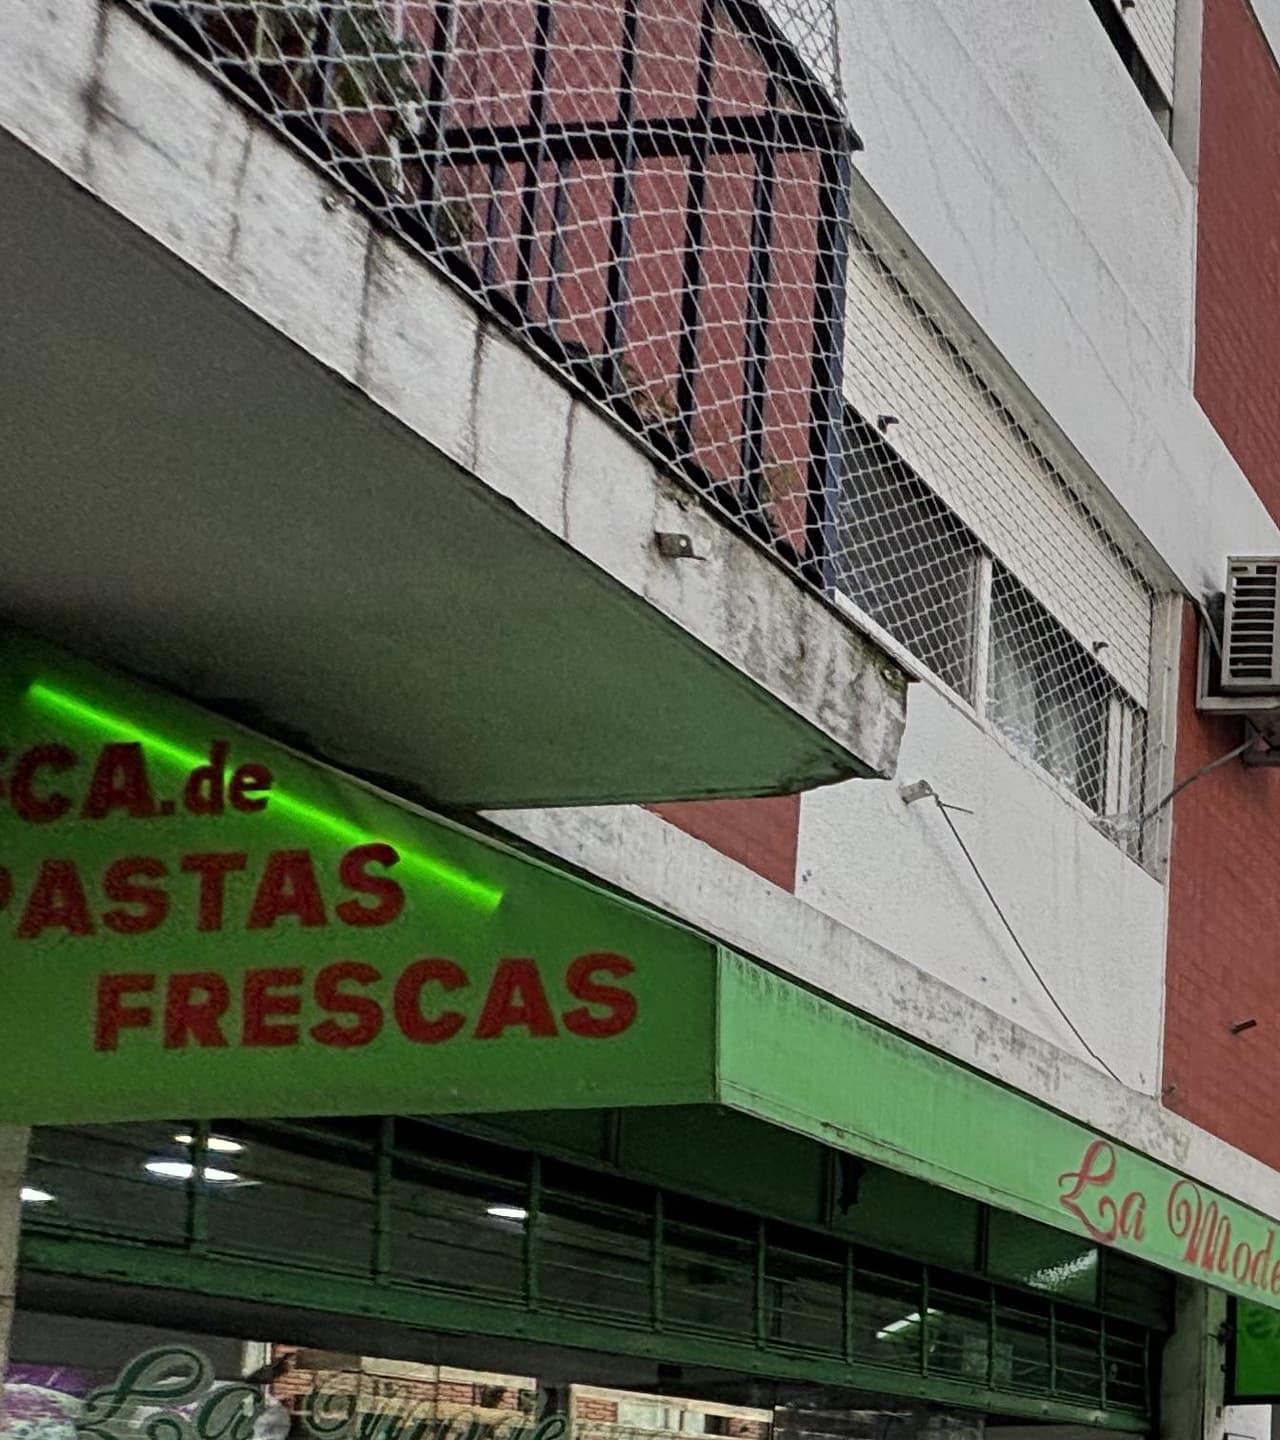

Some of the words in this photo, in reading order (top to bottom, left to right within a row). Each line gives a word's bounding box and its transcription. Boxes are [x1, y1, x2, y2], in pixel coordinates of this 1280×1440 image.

[0, 843, 406, 939] ASTAS
[92, 952, 639, 1053] FRESCAS
[1057, 1138, 1147, 1243] La
